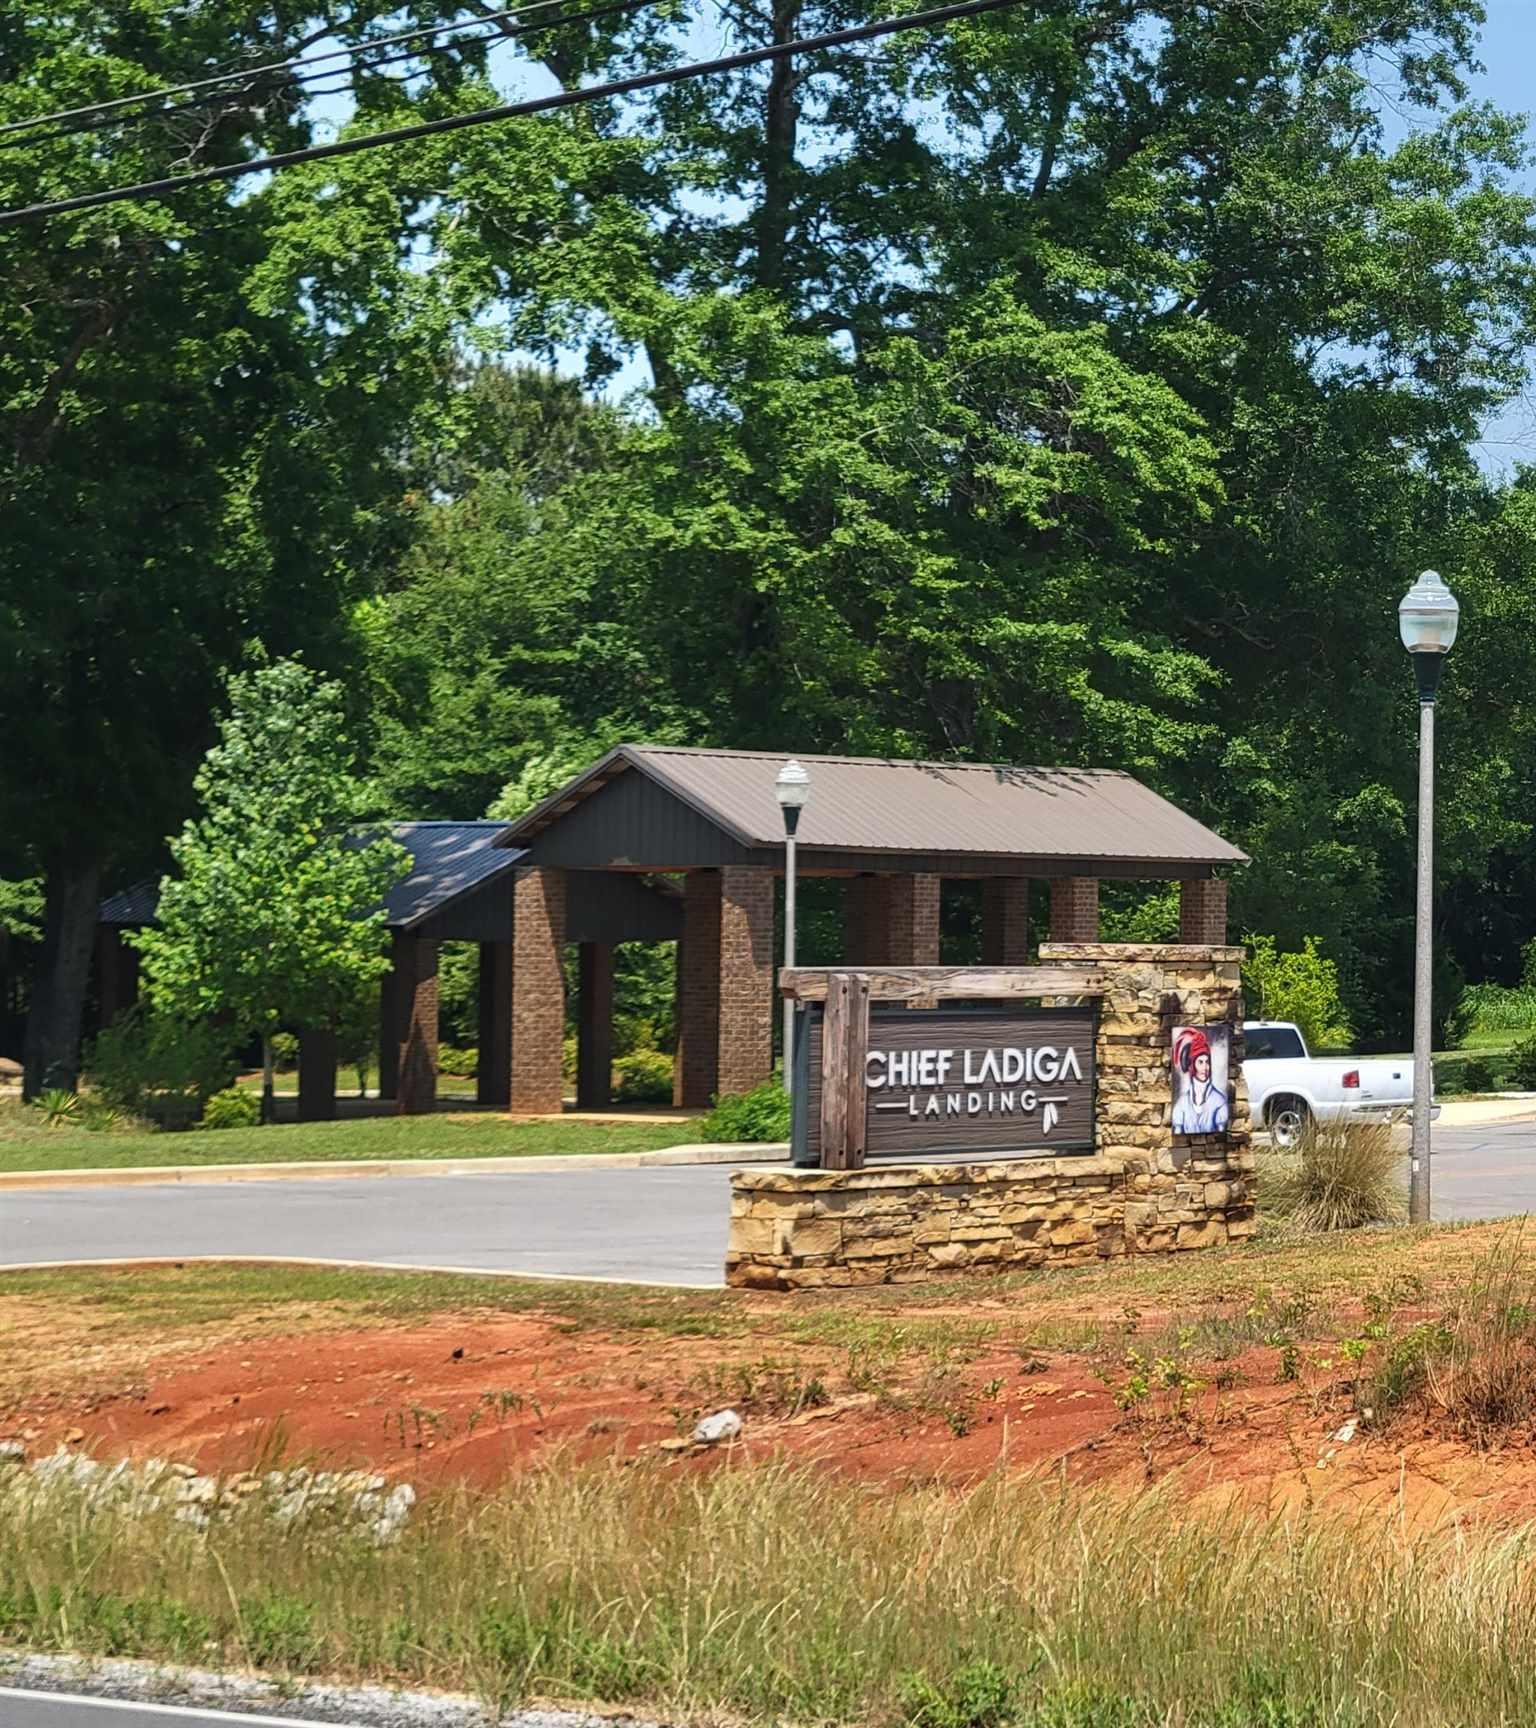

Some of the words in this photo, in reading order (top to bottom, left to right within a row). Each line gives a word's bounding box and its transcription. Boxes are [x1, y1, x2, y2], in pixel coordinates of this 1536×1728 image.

[865, 1050, 953, 1088] CHIEF
[964, 1046, 1083, 1085] LADIGA
[909, 1089, 1037, 1115] LANDING
